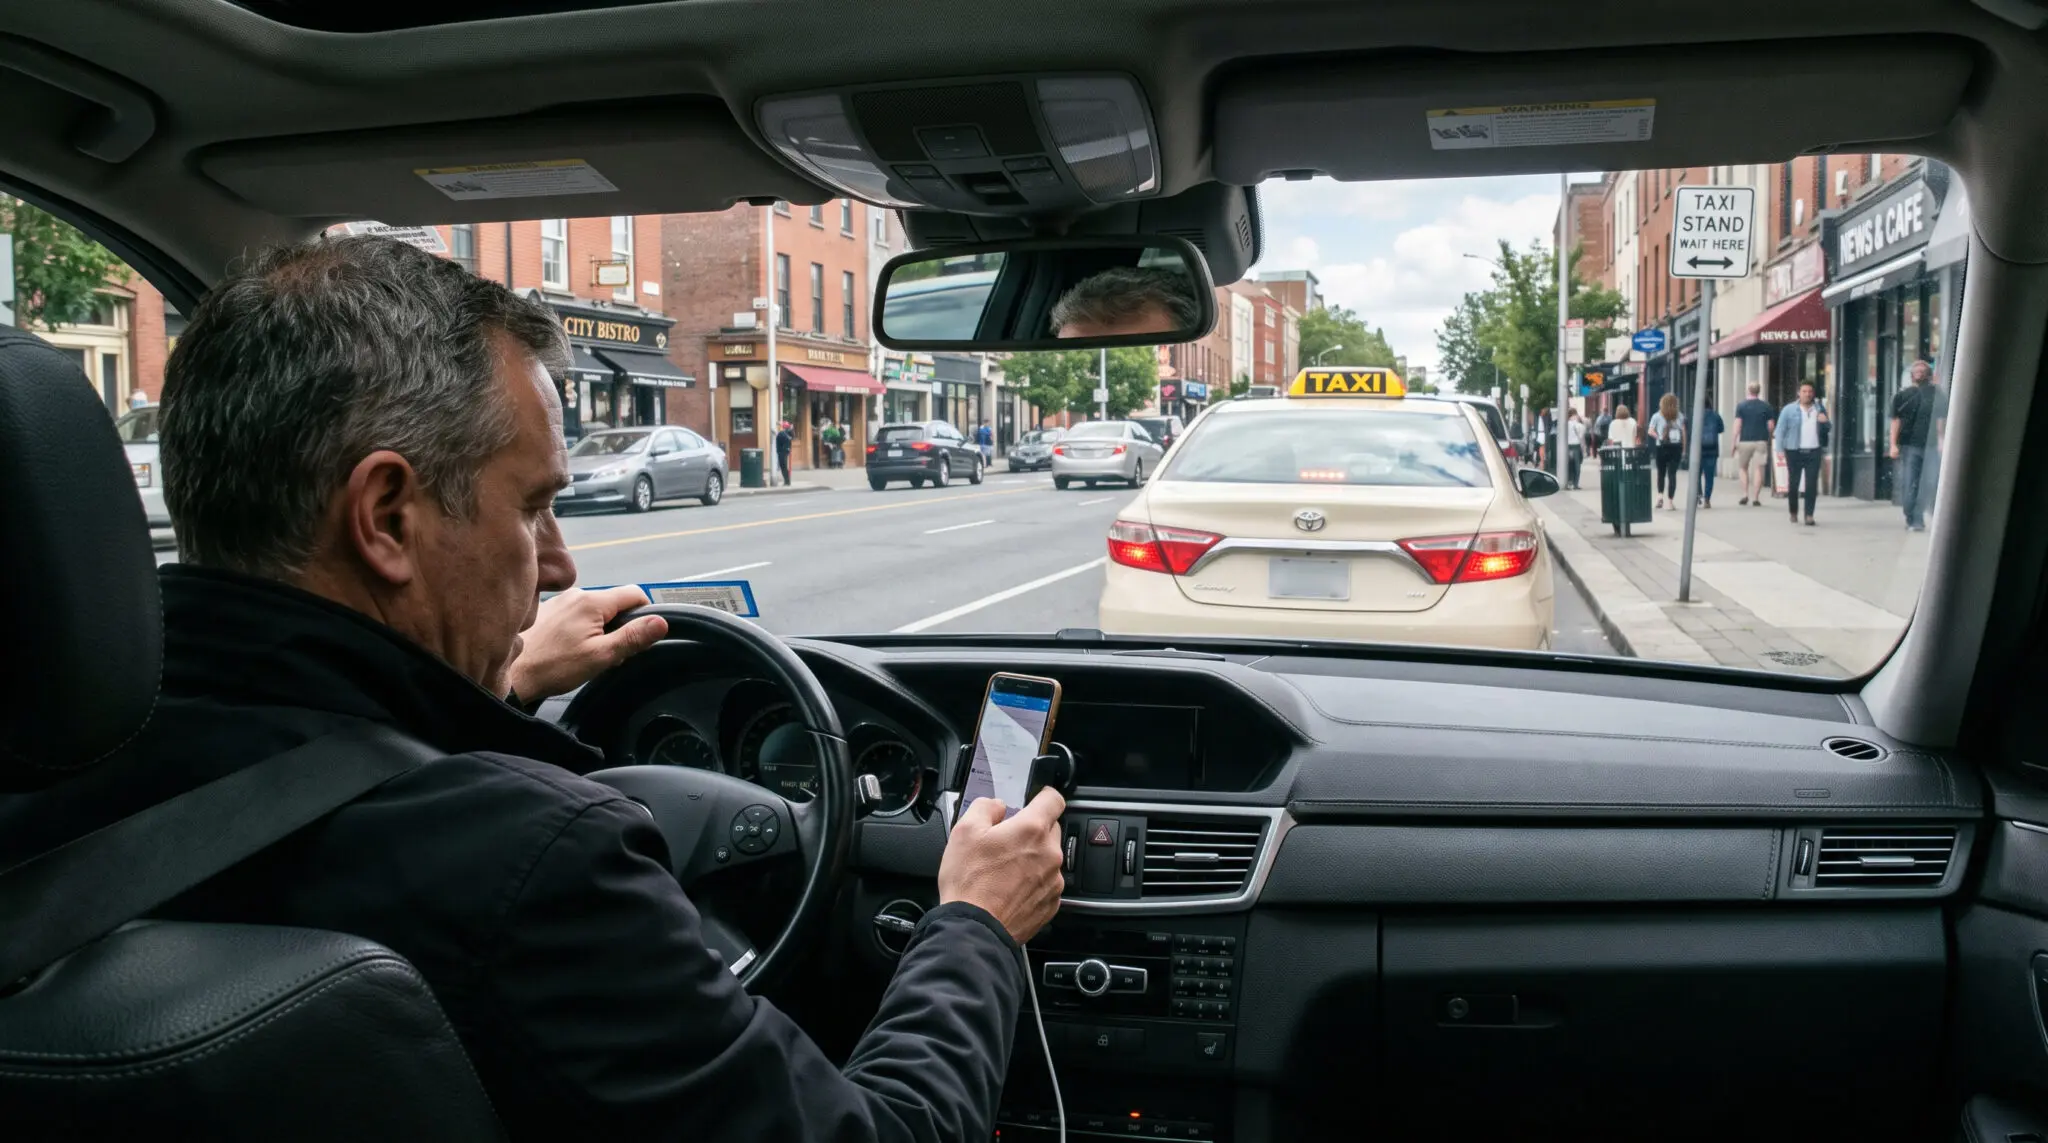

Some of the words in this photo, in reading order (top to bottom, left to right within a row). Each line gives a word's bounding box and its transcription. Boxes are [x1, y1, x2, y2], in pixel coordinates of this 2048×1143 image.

[1500, 102, 1591, 113] WARNING
[1694, 194, 1735, 211] TAXI
[1682, 215, 1744, 233] STAND
[1839, 224, 1873, 266] NEWS
[1885, 191, 1924, 245] CAFE
[1680, 238, 1708, 249] WAIT
[1712, 238, 1745, 251] HERE
[564, 316, 596, 338] CITY
[597, 321, 641, 343] BISTRO
[1760, 330, 1789, 341] NEWS
[1309, 373, 1381, 393] TAXI
